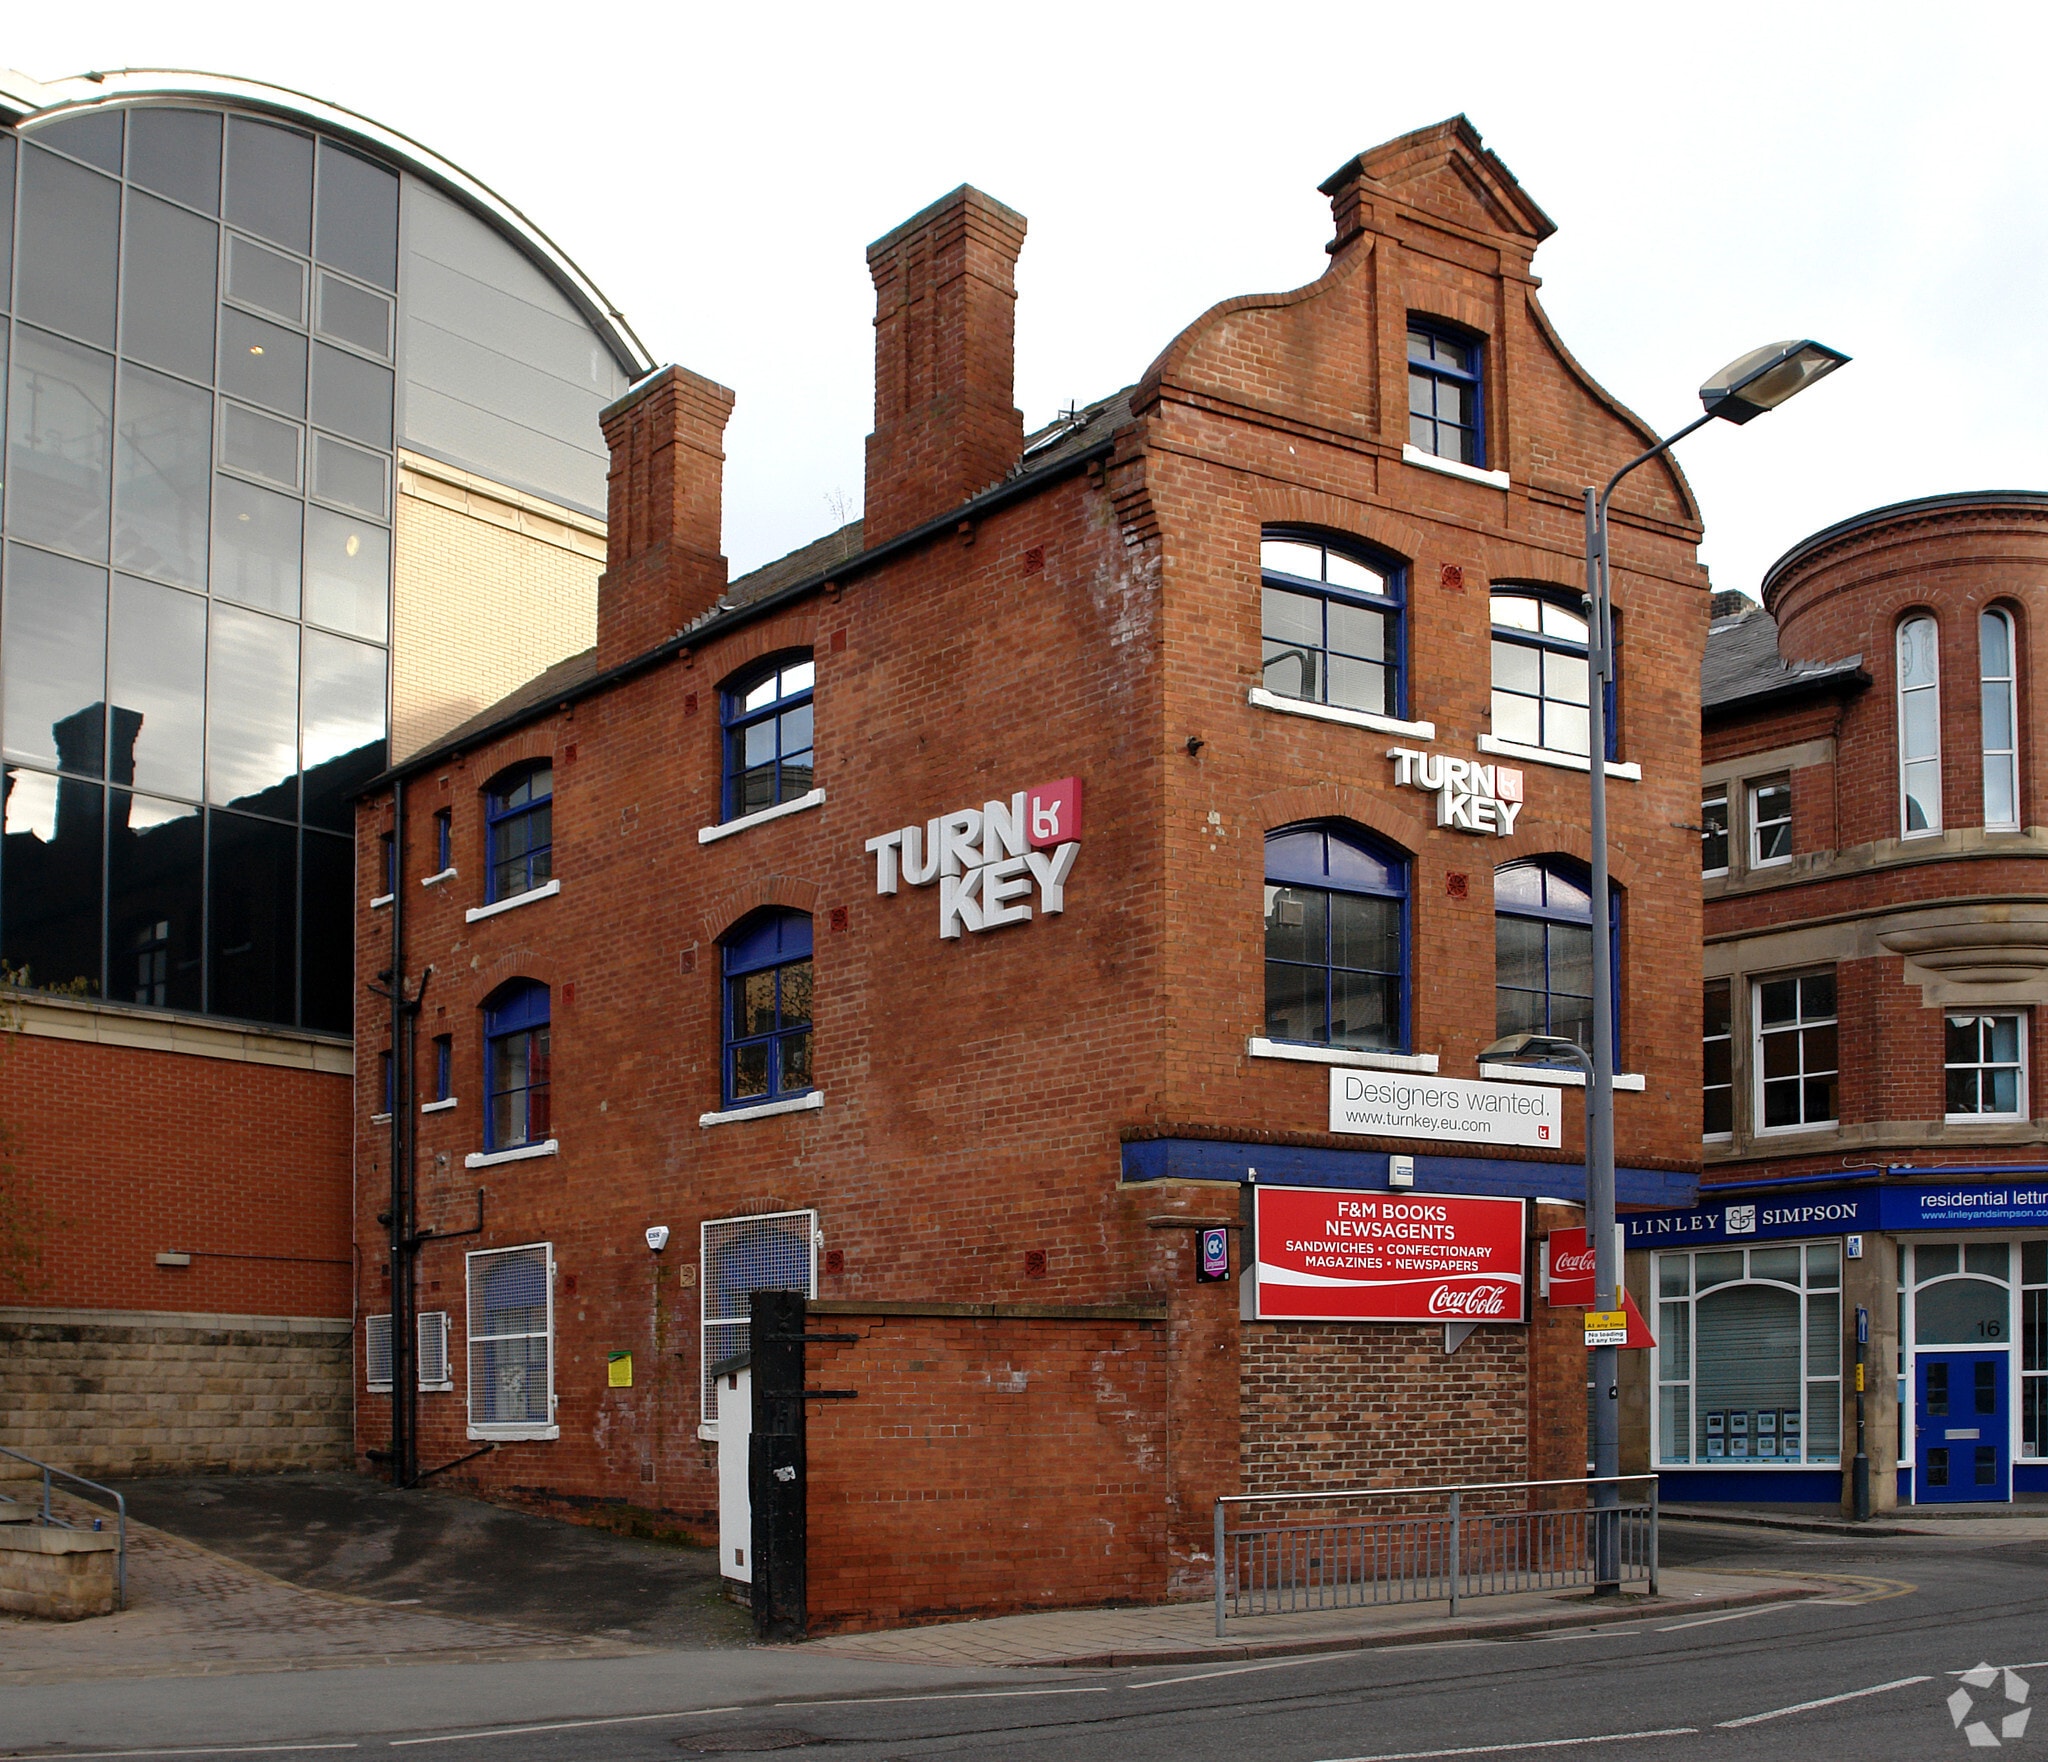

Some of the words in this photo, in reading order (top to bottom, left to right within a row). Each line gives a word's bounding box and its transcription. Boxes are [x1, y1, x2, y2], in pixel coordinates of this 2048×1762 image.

[1386, 747, 1496, 799] TURN
[1437, 790, 1523, 837] KEY
[865, 791, 1031, 895] TURN
[940, 842, 1080, 939] KEY
[1345, 1076, 1460, 1111] Designers
[1466, 1092, 1550, 1117] wanted.
[1345, 1110, 1491, 1133] www.turnkey.eu.com
[1337, 1201, 1377, 1219] F&M
[1382, 1203, 1447, 1221] BOOKS
[1921, 1190, 2008, 1207] residential
[1325, 1220, 1455, 1240] NEWSAGENTS
[1631, 1213, 1719, 1236] LINLEY
[1762, 1203, 1858, 1225] SIMPSON
[1285, 1240, 1374, 1255] SANDWICHES
[1386, 1243, 1492, 1258] CONFECTIONARY
[1305, 1255, 1383, 1269] MAGAZINES
[1395, 1258, 1479, 1272] NEWSPAPERS
[1428, 1284, 1508, 1314] Coca-Cola
[1977, 1320, 2001, 1337] 16
